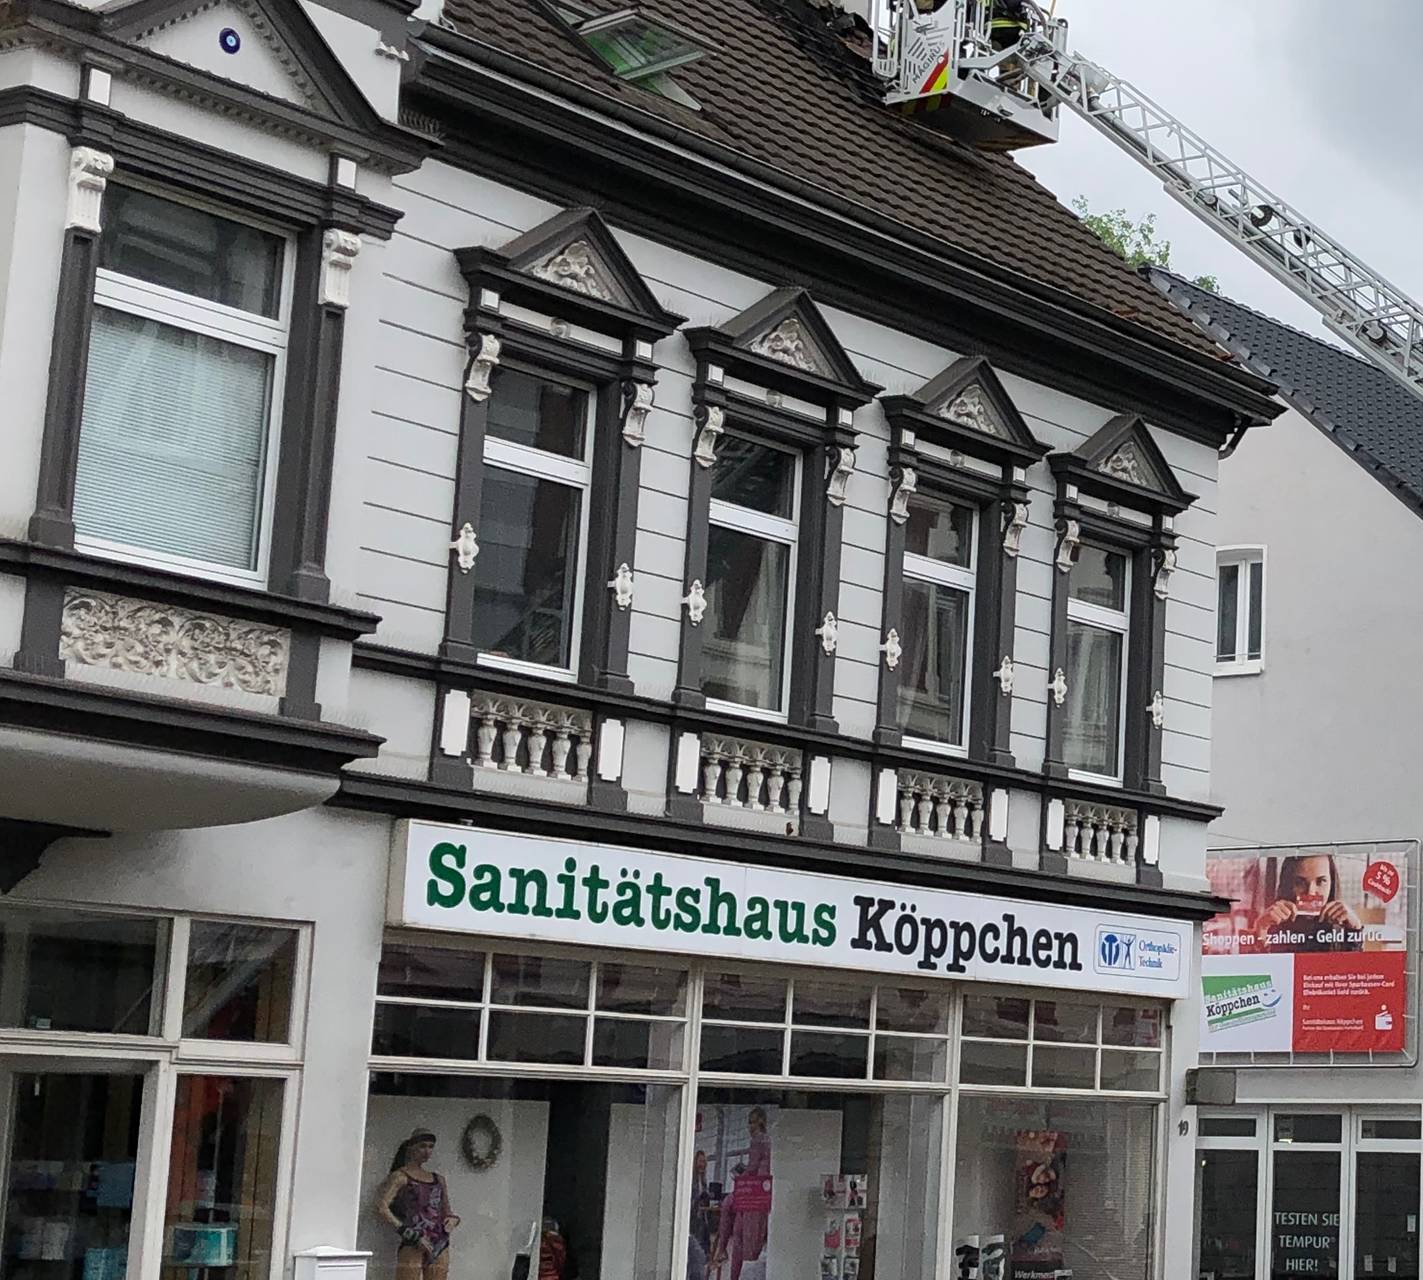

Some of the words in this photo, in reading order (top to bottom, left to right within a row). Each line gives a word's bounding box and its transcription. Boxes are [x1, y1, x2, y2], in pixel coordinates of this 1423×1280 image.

[427, 841, 837, 947] Sanitätshaus
[850, 895, 1083, 973] Köppchen
[1202, 932, 1254, 949] Shoppen
[1265, 930, 1305, 945] zahlen
[1316, 929, 1344, 944] Geld
[1347, 926, 1384, 943] zurüc
[1205, 994, 1261, 1018] Köppchen
[1177, 1119, 1189, 1137] 19
[1274, 1212, 1317, 1226] TESTEN
[1321, 1213, 1340, 1226] SIE
[1286, 1258, 1318, 1272] HIER!
